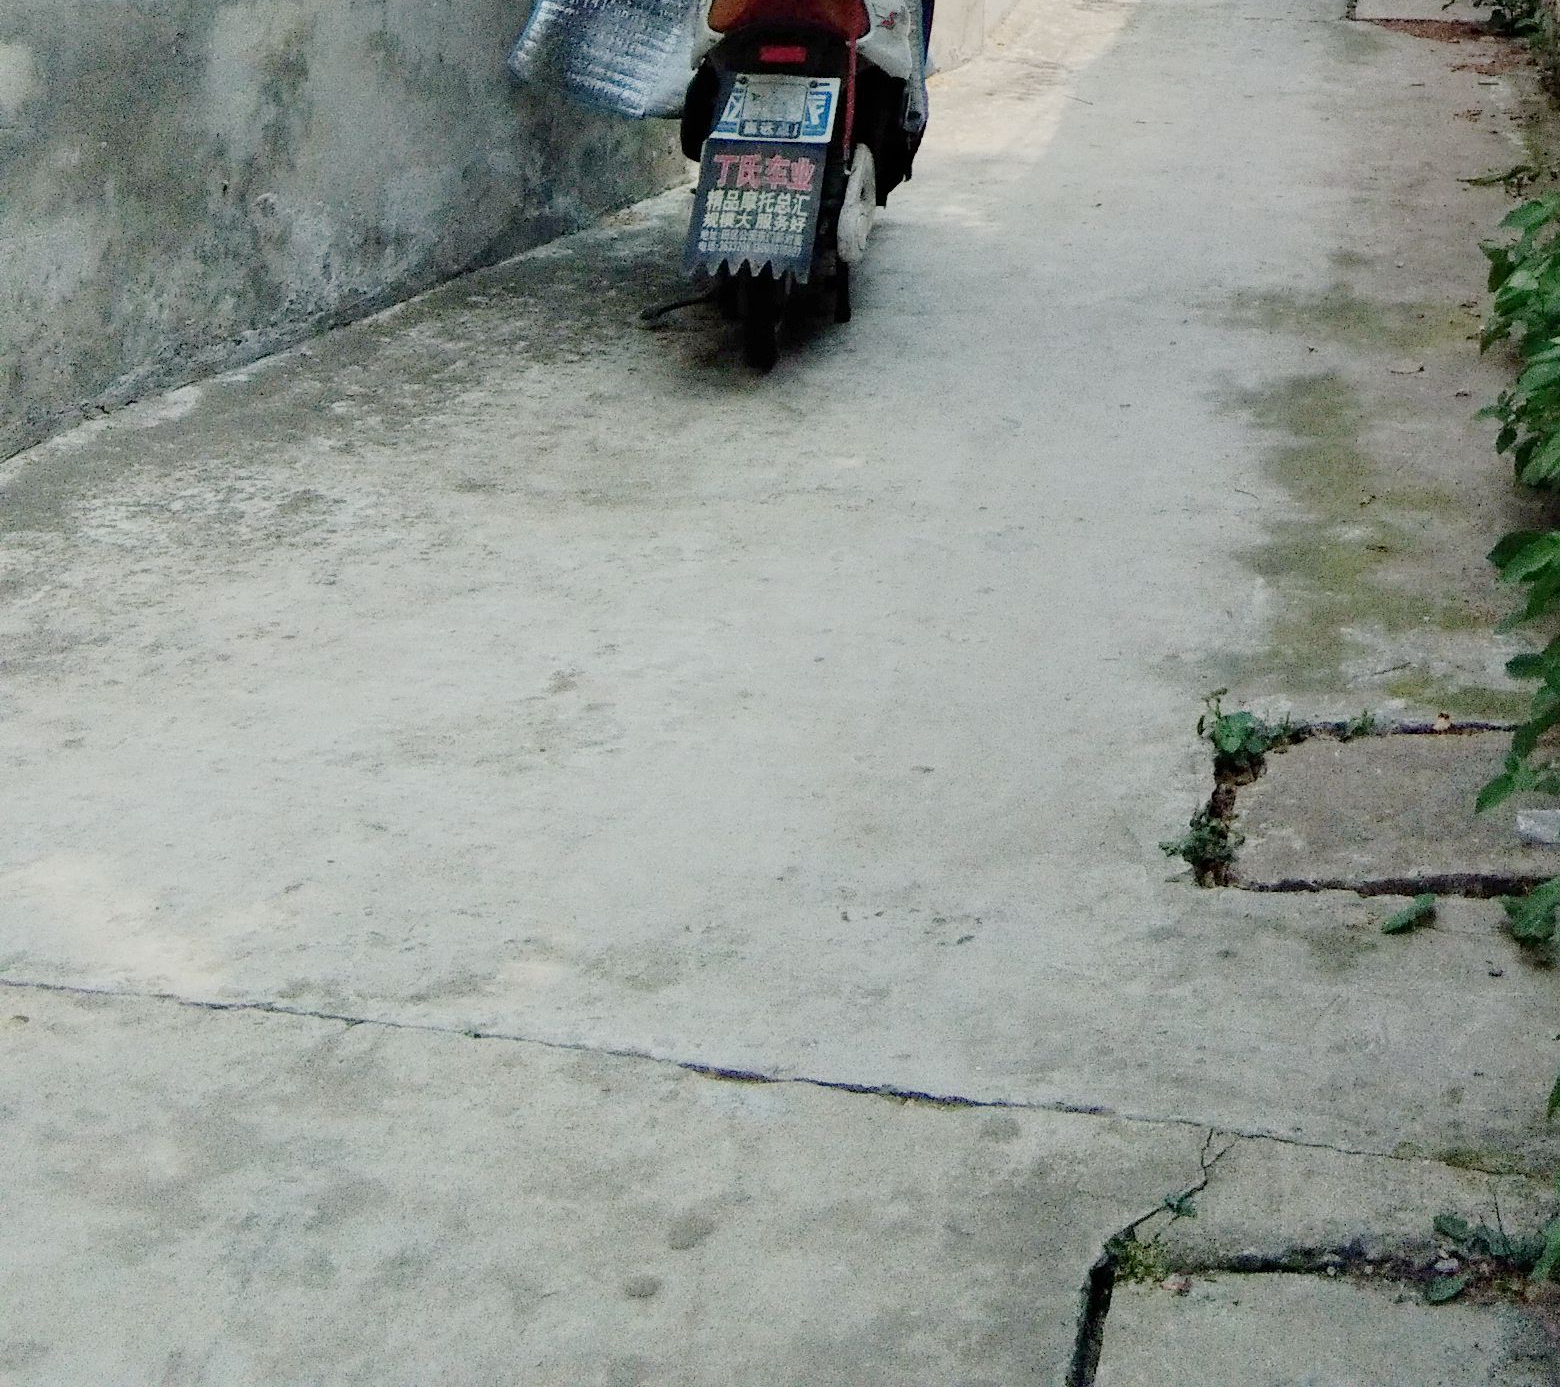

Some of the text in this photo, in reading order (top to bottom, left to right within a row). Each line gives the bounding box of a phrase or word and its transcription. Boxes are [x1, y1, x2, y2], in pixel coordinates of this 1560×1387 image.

[713, 153, 816, 192] 丁氏车业
[706, 188, 811, 217] 精品摩托总汇
